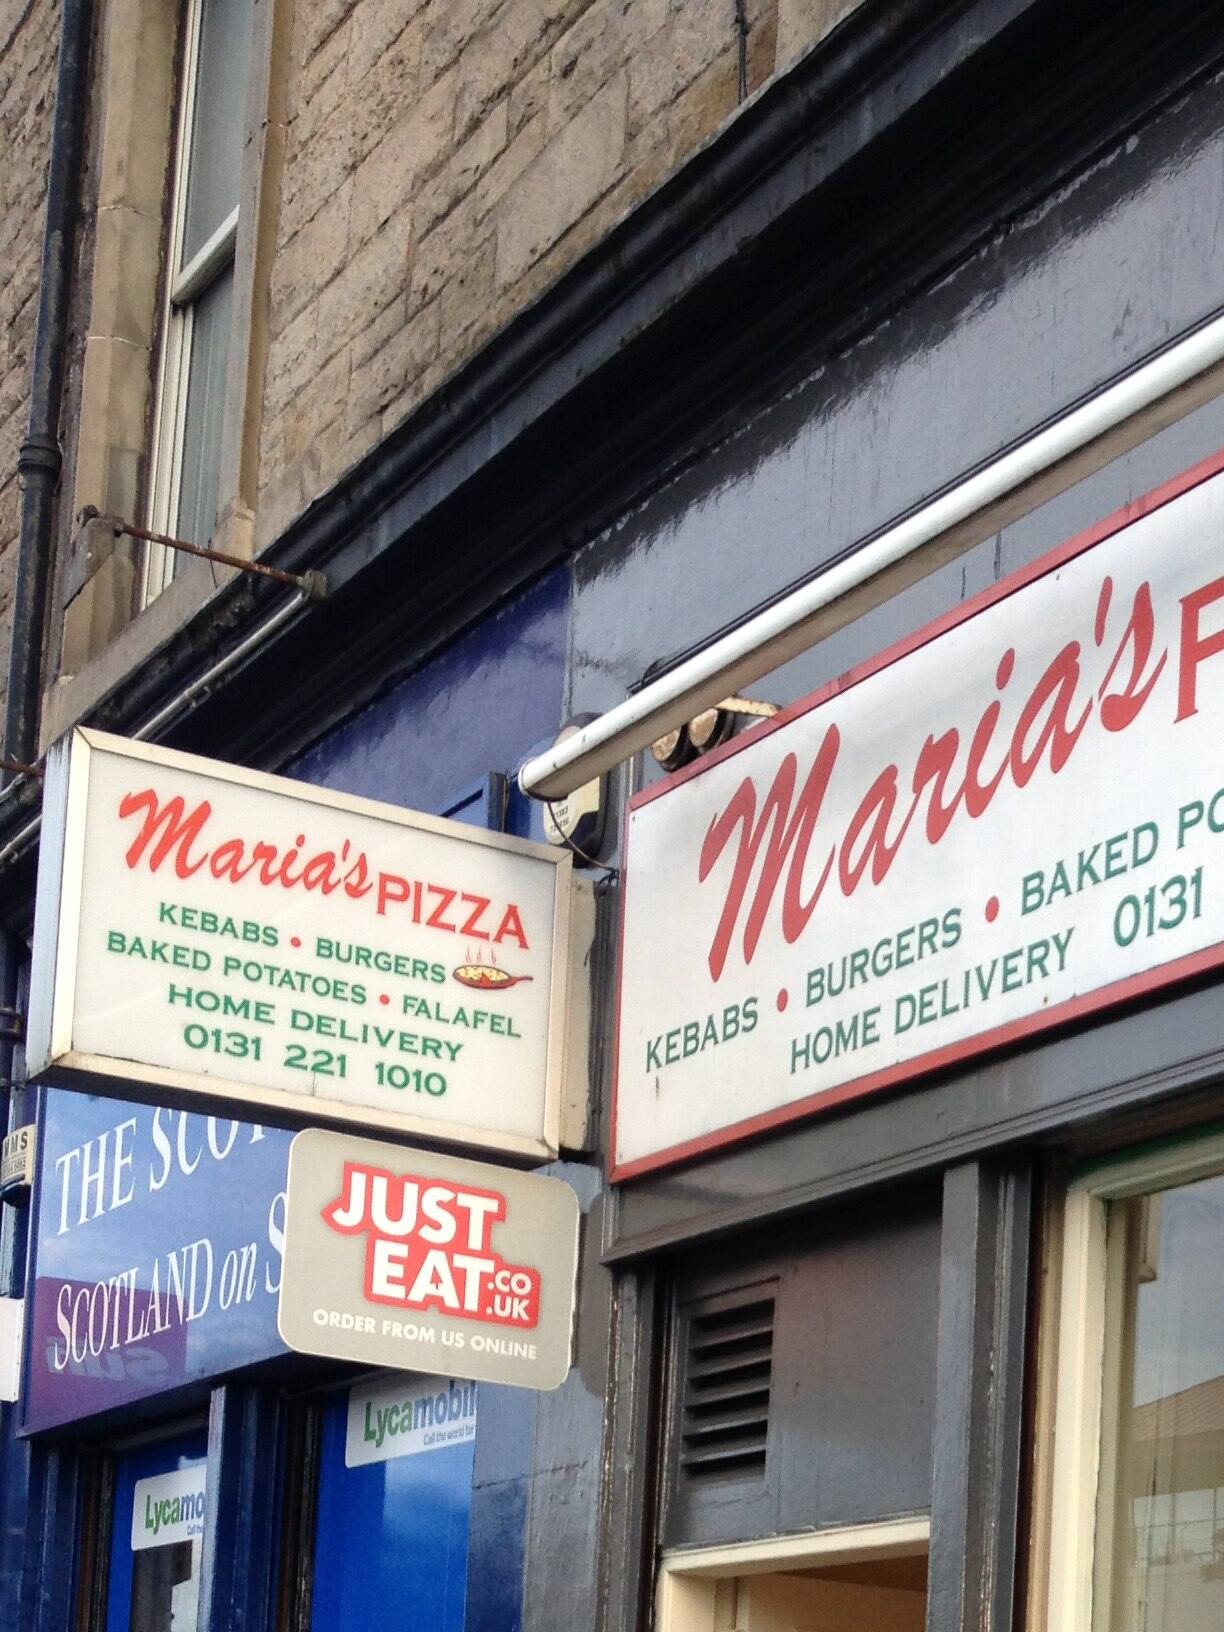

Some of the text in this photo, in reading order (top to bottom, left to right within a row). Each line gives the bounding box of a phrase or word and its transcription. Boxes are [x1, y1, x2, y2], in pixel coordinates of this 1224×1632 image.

[699, 575, 1168, 983] Maria's
[119, 788, 530, 950] Maria's PIZZA
[107, 930, 522, 1038] BAKED POTATOES FALAFEL
[158, 902, 447, 984] KEBABS BURGERS
[645, 996, 759, 1073] KEBABS
[805, 907, 962, 1007] BURGERS
[1021, 821, 1159, 916] BAKED
[789, 1006, 881, 1074] HOME
[894, 928, 1075, 1036] DELIVERY
[1113, 866, 1203, 947] 0131
[168, 983, 464, 1062] HOME DELIVERY
[183, 1023, 447, 1096] 0131 221 1010
[55, 1117, 137, 1236] THE
[331, 1171, 499, 1251] JUST
[54, 1238, 213, 1370] SCOTLAND
[219, 1242, 257, 1310] on
[372, 1239, 495, 1312] EAT
[313, 1309, 537, 1360] ORDER FROM US ONLINE
